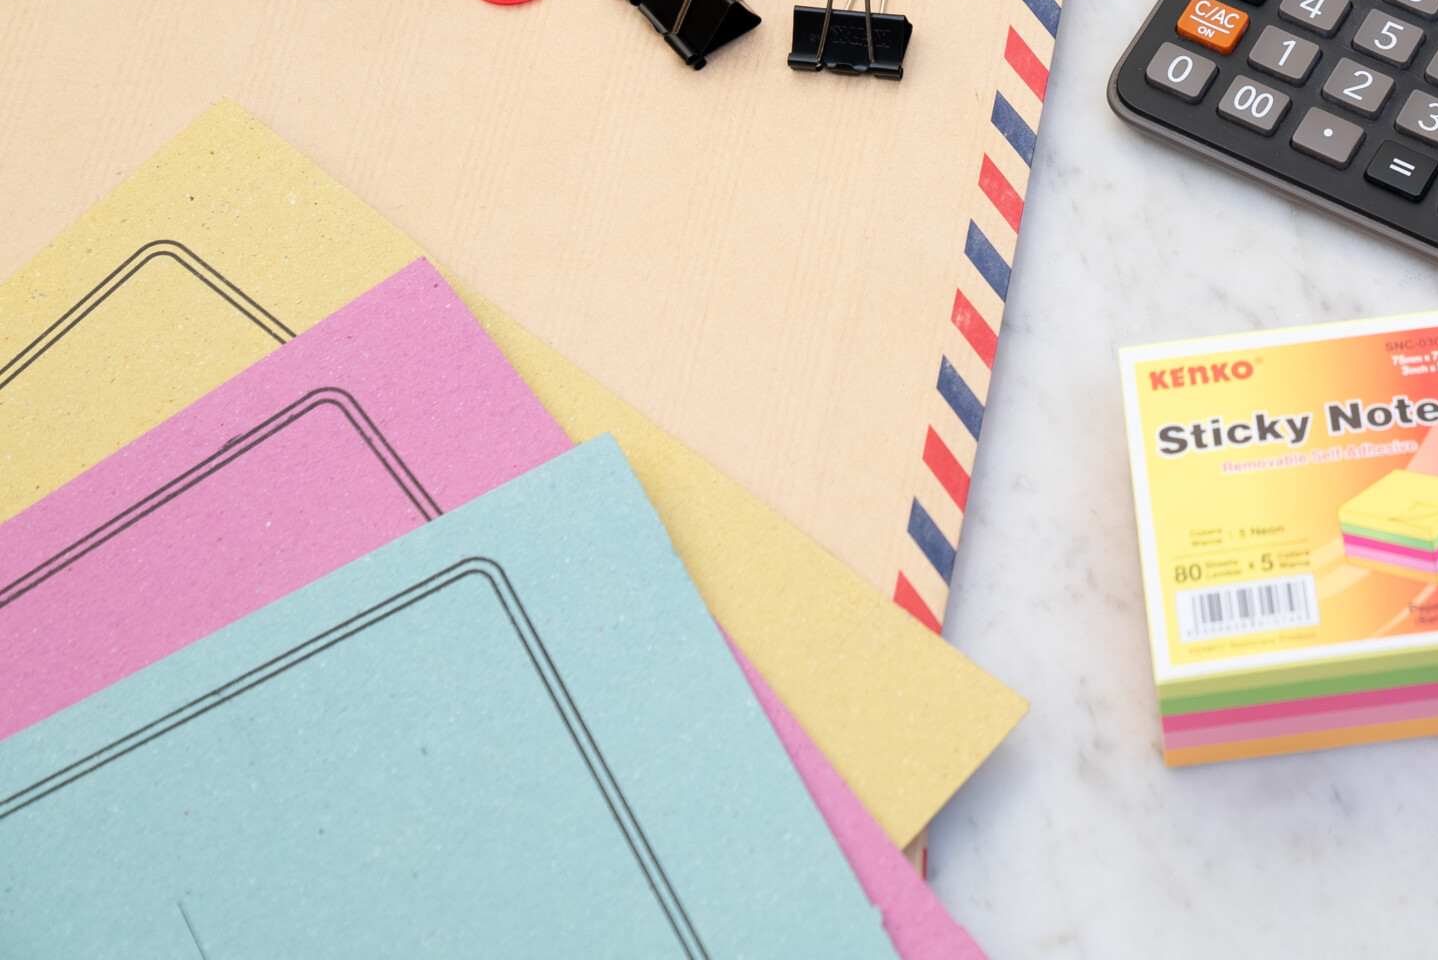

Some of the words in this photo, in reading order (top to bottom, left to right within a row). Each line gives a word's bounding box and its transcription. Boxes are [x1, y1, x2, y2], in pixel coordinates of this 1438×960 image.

[1194, 0, 1240, 29] C/AC
[1197, 26, 1215, 39] ON
[1374, 20, 1404, 50] 5
[1278, 40, 1296, 67] 1
[1167, 55, 1193, 83] 0
[1343, 70, 1373, 101] 2
[1233, 85, 1274, 118] 00
[1158, 413, 1311, 455] Sticky
[1222, 451, 1309, 474] Removable
[1175, 563, 1203, 583] 80
[1261, 553, 1274, 572] 5
